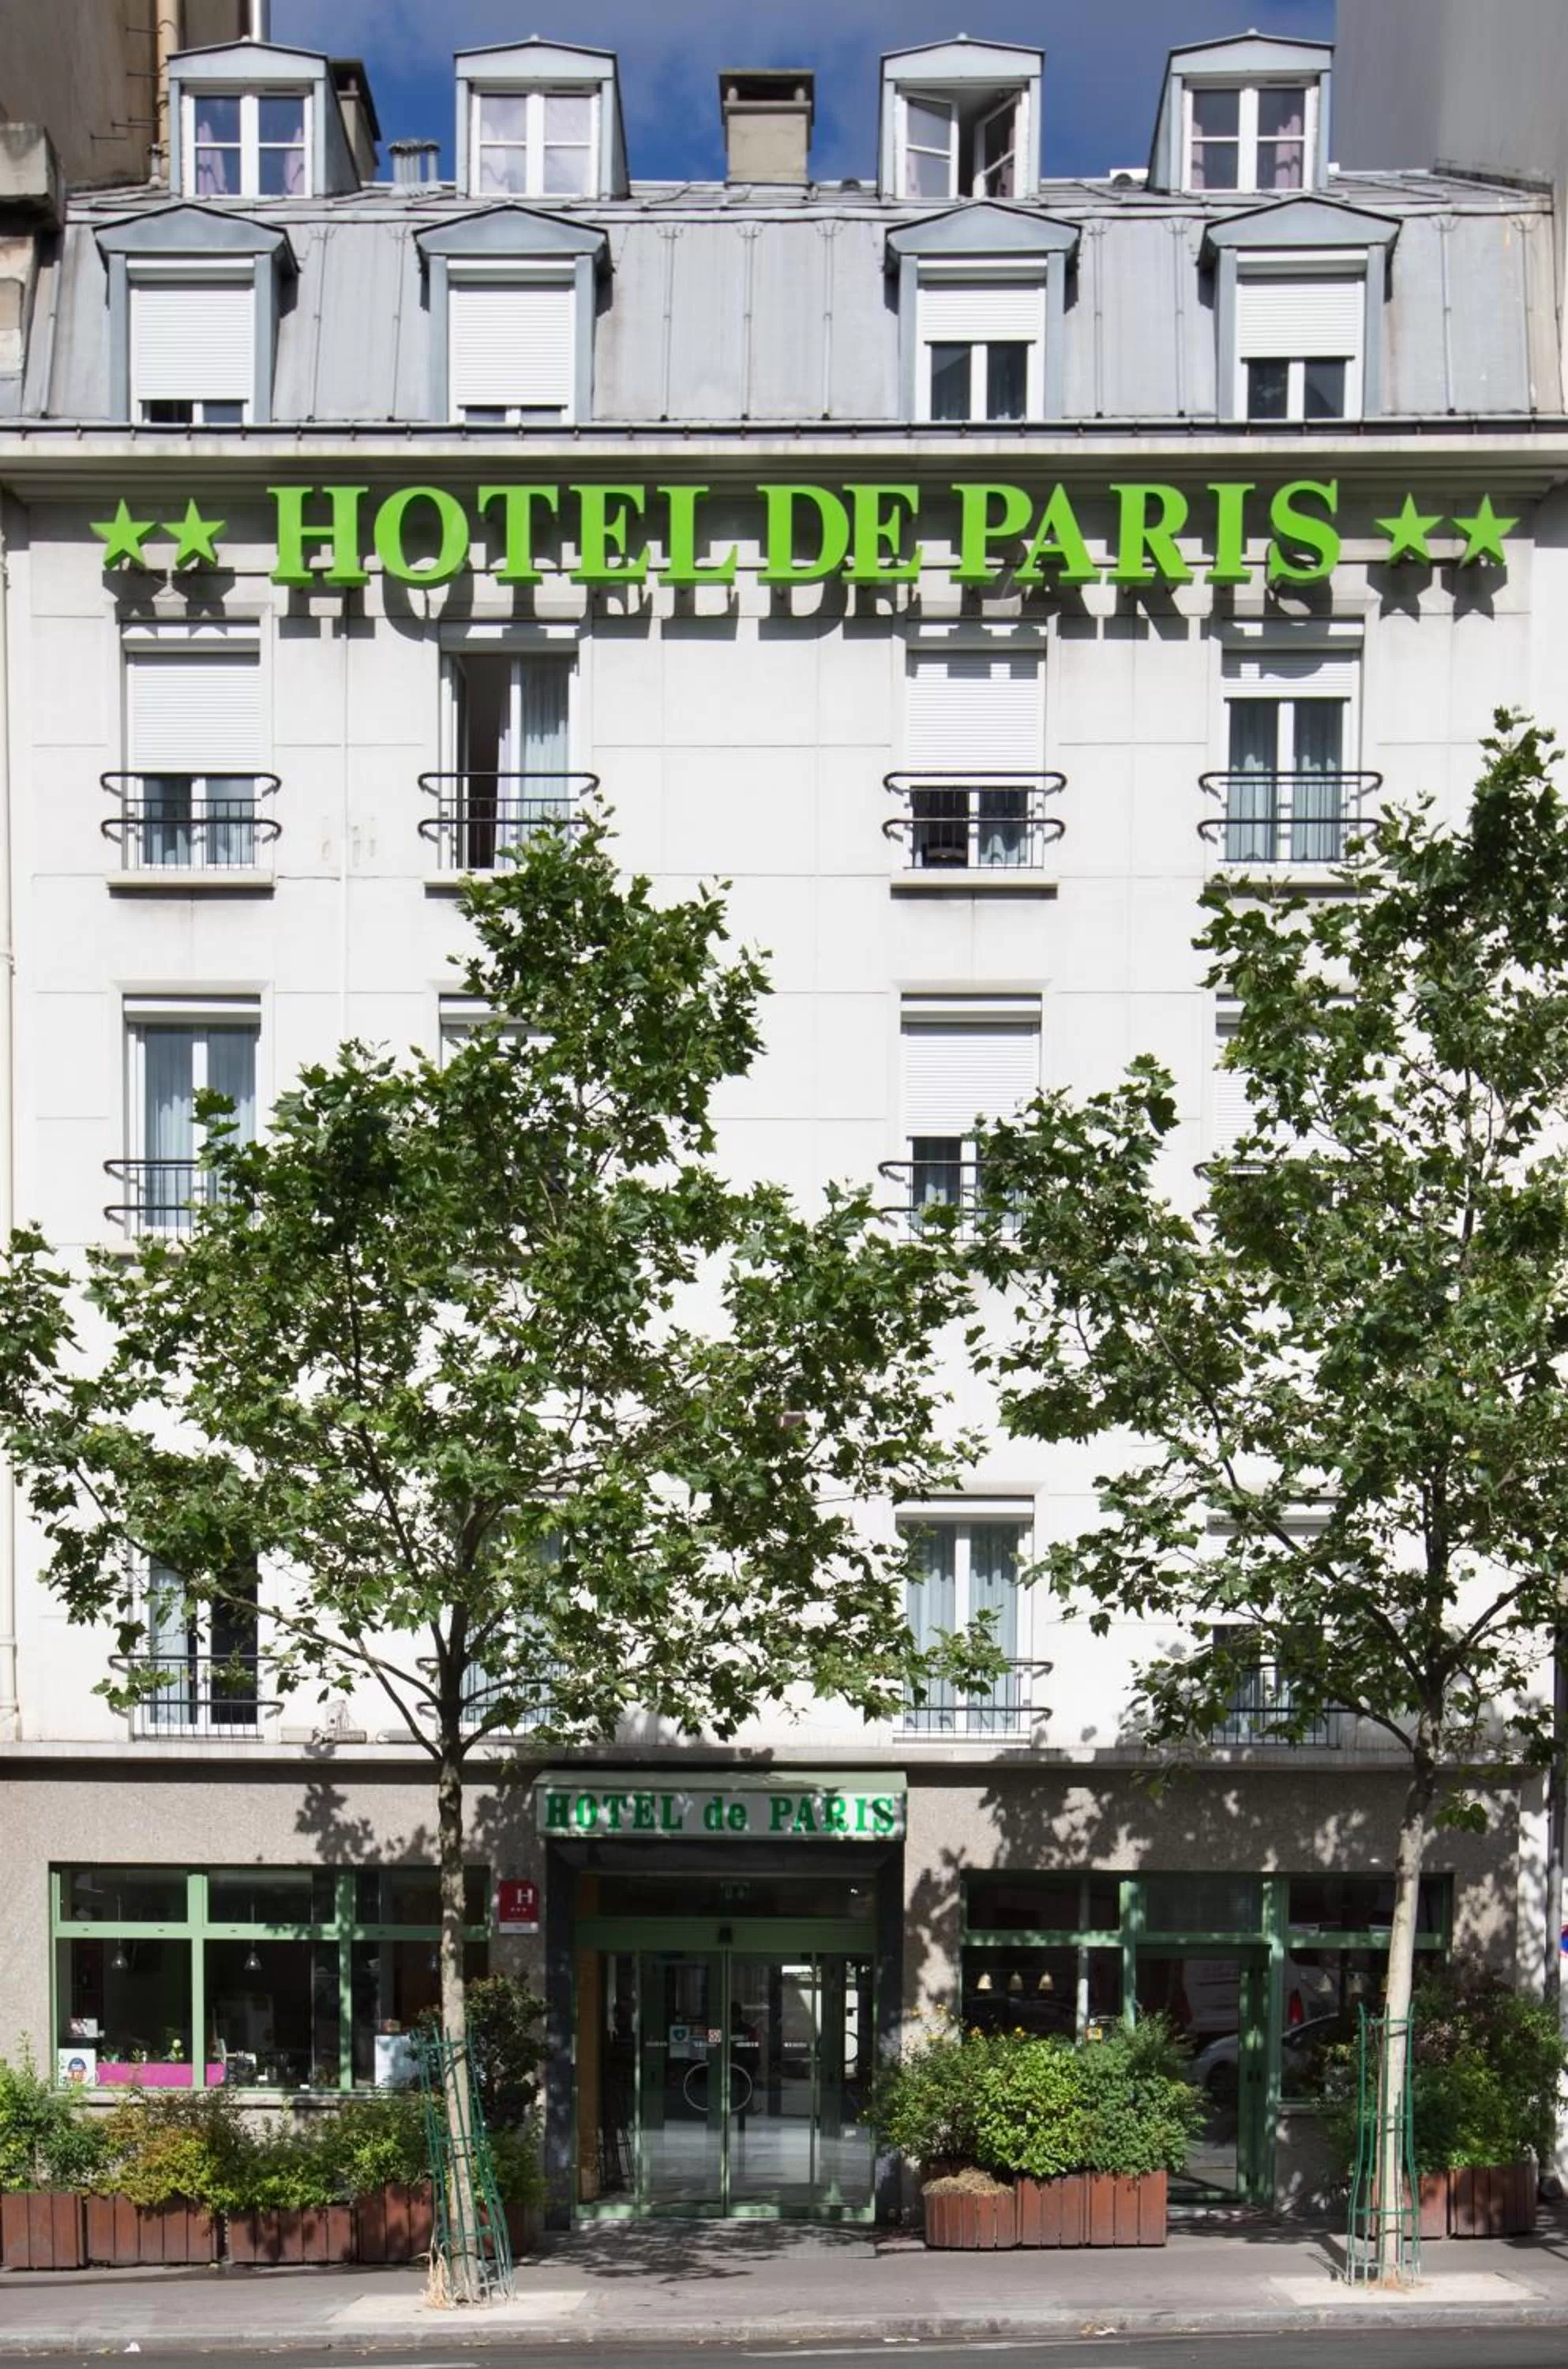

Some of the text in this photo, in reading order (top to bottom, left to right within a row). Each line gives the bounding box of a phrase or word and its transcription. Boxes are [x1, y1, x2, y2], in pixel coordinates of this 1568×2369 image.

[266, 479, 1341, 587] HOTEL DE PARIS
[545, 1793, 895, 1833] HOTEL de PARIS
[517, 1888, 533, 1904] H
